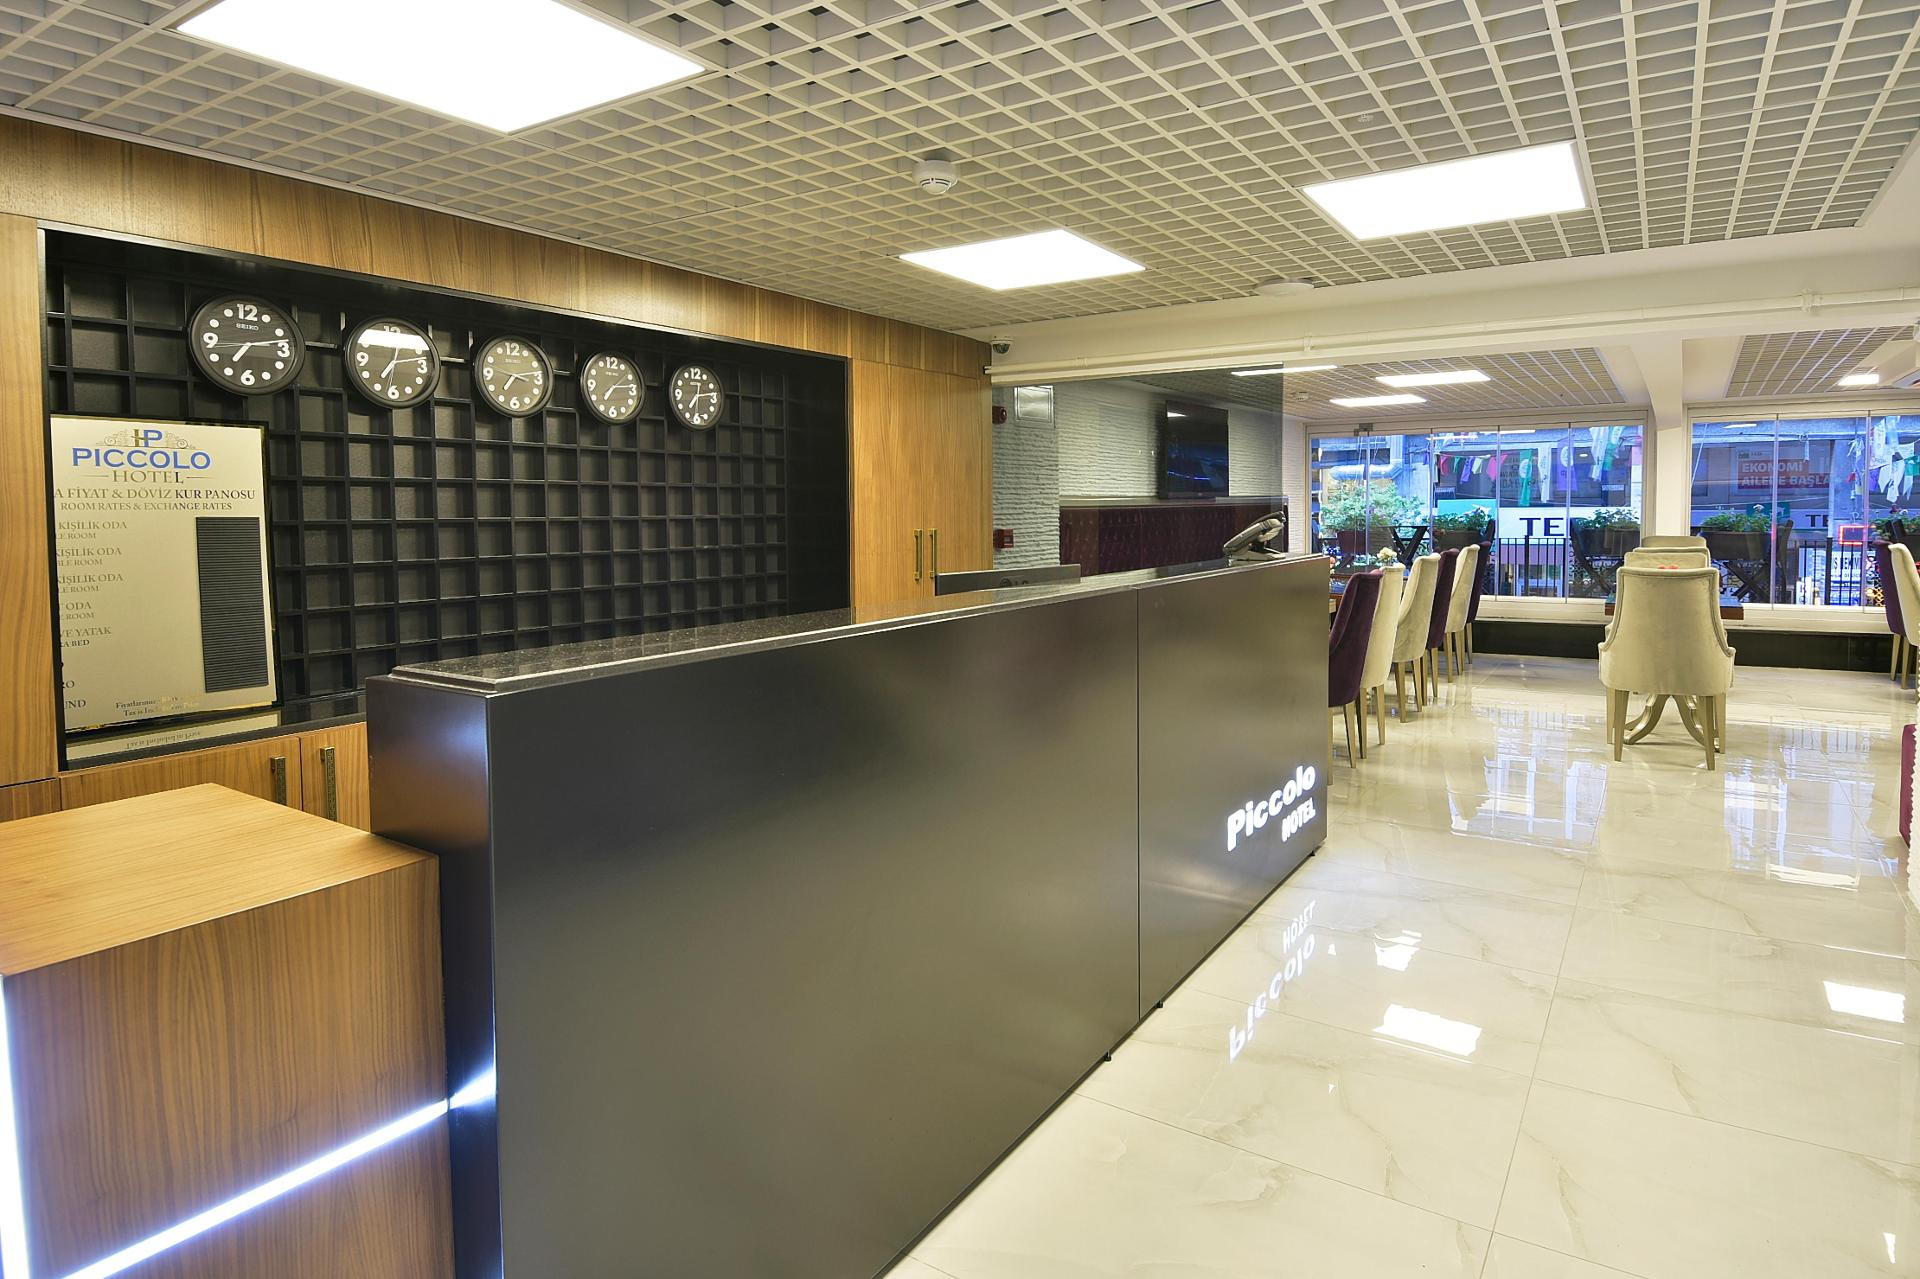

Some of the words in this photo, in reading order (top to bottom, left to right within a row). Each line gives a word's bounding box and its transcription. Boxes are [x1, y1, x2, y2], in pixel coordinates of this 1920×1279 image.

[237, 303, 258, 322] 12
[236, 323, 259, 331] SEIKO
[203, 332, 218, 348] 9
[277, 341, 290, 357] 3
[504, 342, 520, 356] 12
[356, 352, 368, 366] 9
[605, 357, 618, 369] 12
[417, 359, 428, 374] 3
[240, 370, 255, 385] 6
[483, 367, 494, 380] 9
[534, 371, 543, 385] 3
[690, 368, 701, 380] 12
[587, 379, 596, 391] 9
[628, 384, 637, 396] 3
[388, 385, 399, 399] 6
[674, 388, 682, 400] 9
[509, 396, 520, 409] 6
[608, 405, 618, 418] 6
[692, 413, 701, 424] 6
[72, 447, 211, 469] PICCOLO
[112, 470, 184, 484] HOTEL
[67, 486, 109, 499] FİYAT
[111, 488, 123, 499] &
[127, 486, 172, 499] DÖVİZ
[175, 489, 202, 499] KUR
[205, 489, 256, 500] PANOSU
[61, 502, 96, 511] ROOM
[98, 502, 131, 511] RATES
[133, 502, 142, 511] &
[144, 502, 201, 511] EXCHANGE
[202, 502, 233, 511] RATES
[102, 521, 128, 530] ODA
[67, 532, 97, 540] ROOM
[96, 547, 122, 556] ODA
[98, 573, 124, 582] ODA
[70, 585, 100, 593] ROOM
[65, 601, 92, 611] ODA
[75, 626, 112, 638] YATAK
[72, 639, 90, 647] BED
[1227, 765, 1316, 852] Piccolo
[1281, 797, 1316, 842] HOTEL
